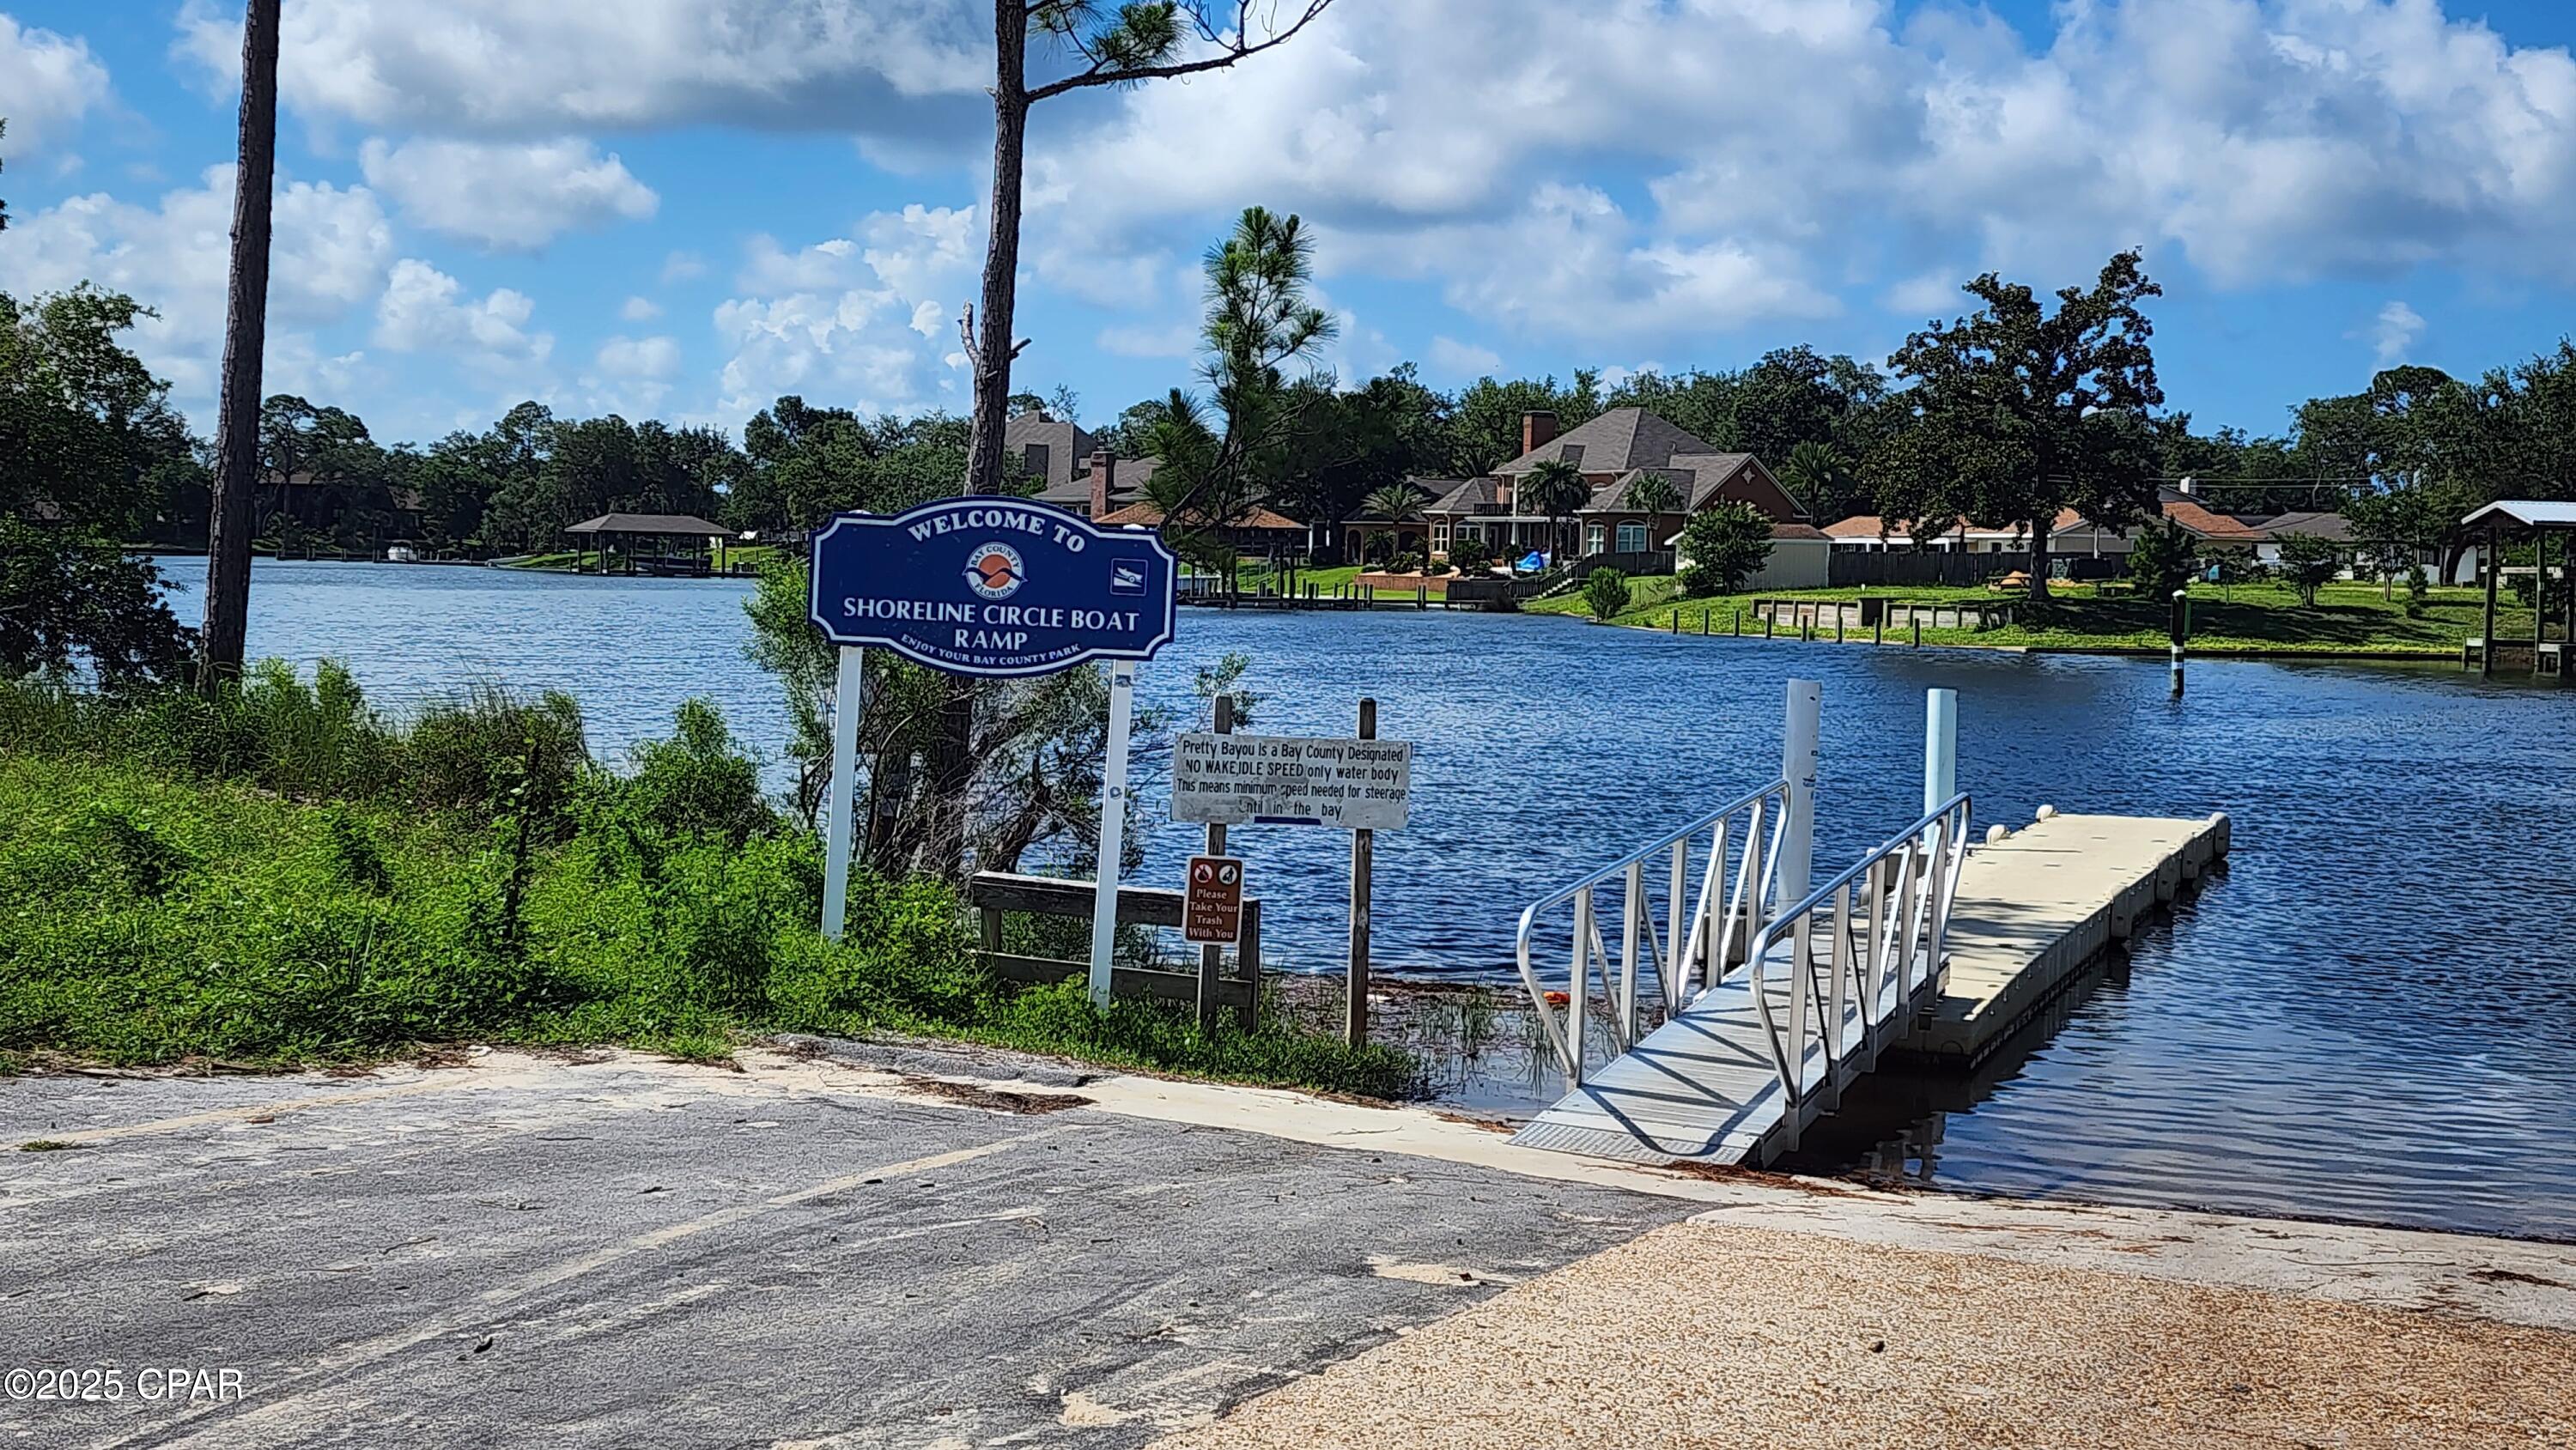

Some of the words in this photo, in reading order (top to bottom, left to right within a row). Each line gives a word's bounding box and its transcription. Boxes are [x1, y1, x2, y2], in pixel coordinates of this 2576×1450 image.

[908, 510, 1045, 542] WELCOME
[1053, 525, 1085, 552] TO
[970, 549, 985, 566] BAY
[986, 546, 1020, 567] COUNTY
[975, 584, 1013, 597] FLORIDA
[843, 598, 975, 624] SHORELINE
[983, 604, 1064, 628] CIRCLE
[1071, 610, 1139, 632] BOAT
[901, 634, 937, 654] ENJOY
[939, 648, 969, 662] YOUR
[973, 655, 996, 665] BAY
[999, 652, 1046, 665] COUNTY
[1048, 643, 1081, 659] PARK
[955, 628, 1028, 651] RAMP
[1182, 740, 1218, 760] Pretty
[1221, 742, 1255, 760] Bayou
[1258, 743, 1267, 756] Is
[1271, 746, 1278, 756] a
[1281, 743, 1302, 762] Bay
[1306, 744, 1344, 764] County
[1348, 746, 1403, 765] Designated
[1186, 759, 1200, 774] NO
[1267, 762, 1303, 777] SPEED
[1307, 765, 1332, 782] only
[1336, 766, 1368, 780] water
[1371, 767, 1399, 785] body
[1177, 778, 1195, 792] This
[1198, 781, 1230, 793] means
[1233, 780, 1277, 795] minimum
[1280, 783, 1308, 798] speed
[1311, 784, 1345, 798] needed
[1347, 784, 1362, 798] for
[1365, 786, 1406, 804] steerage
[1273, 800, 1283, 814] in
[1294, 802, 1311, 816] the
[1321, 803, 1342, 821] bay
[1196, 889, 1227, 899] Please
[1189, 901, 1212, 911] Take
[1215, 902, 1238, 913] Your
[1195, 915, 1223, 925] Trash
[1189, 927, 1212, 937] With
[1215, 929, 1234, 938] You
